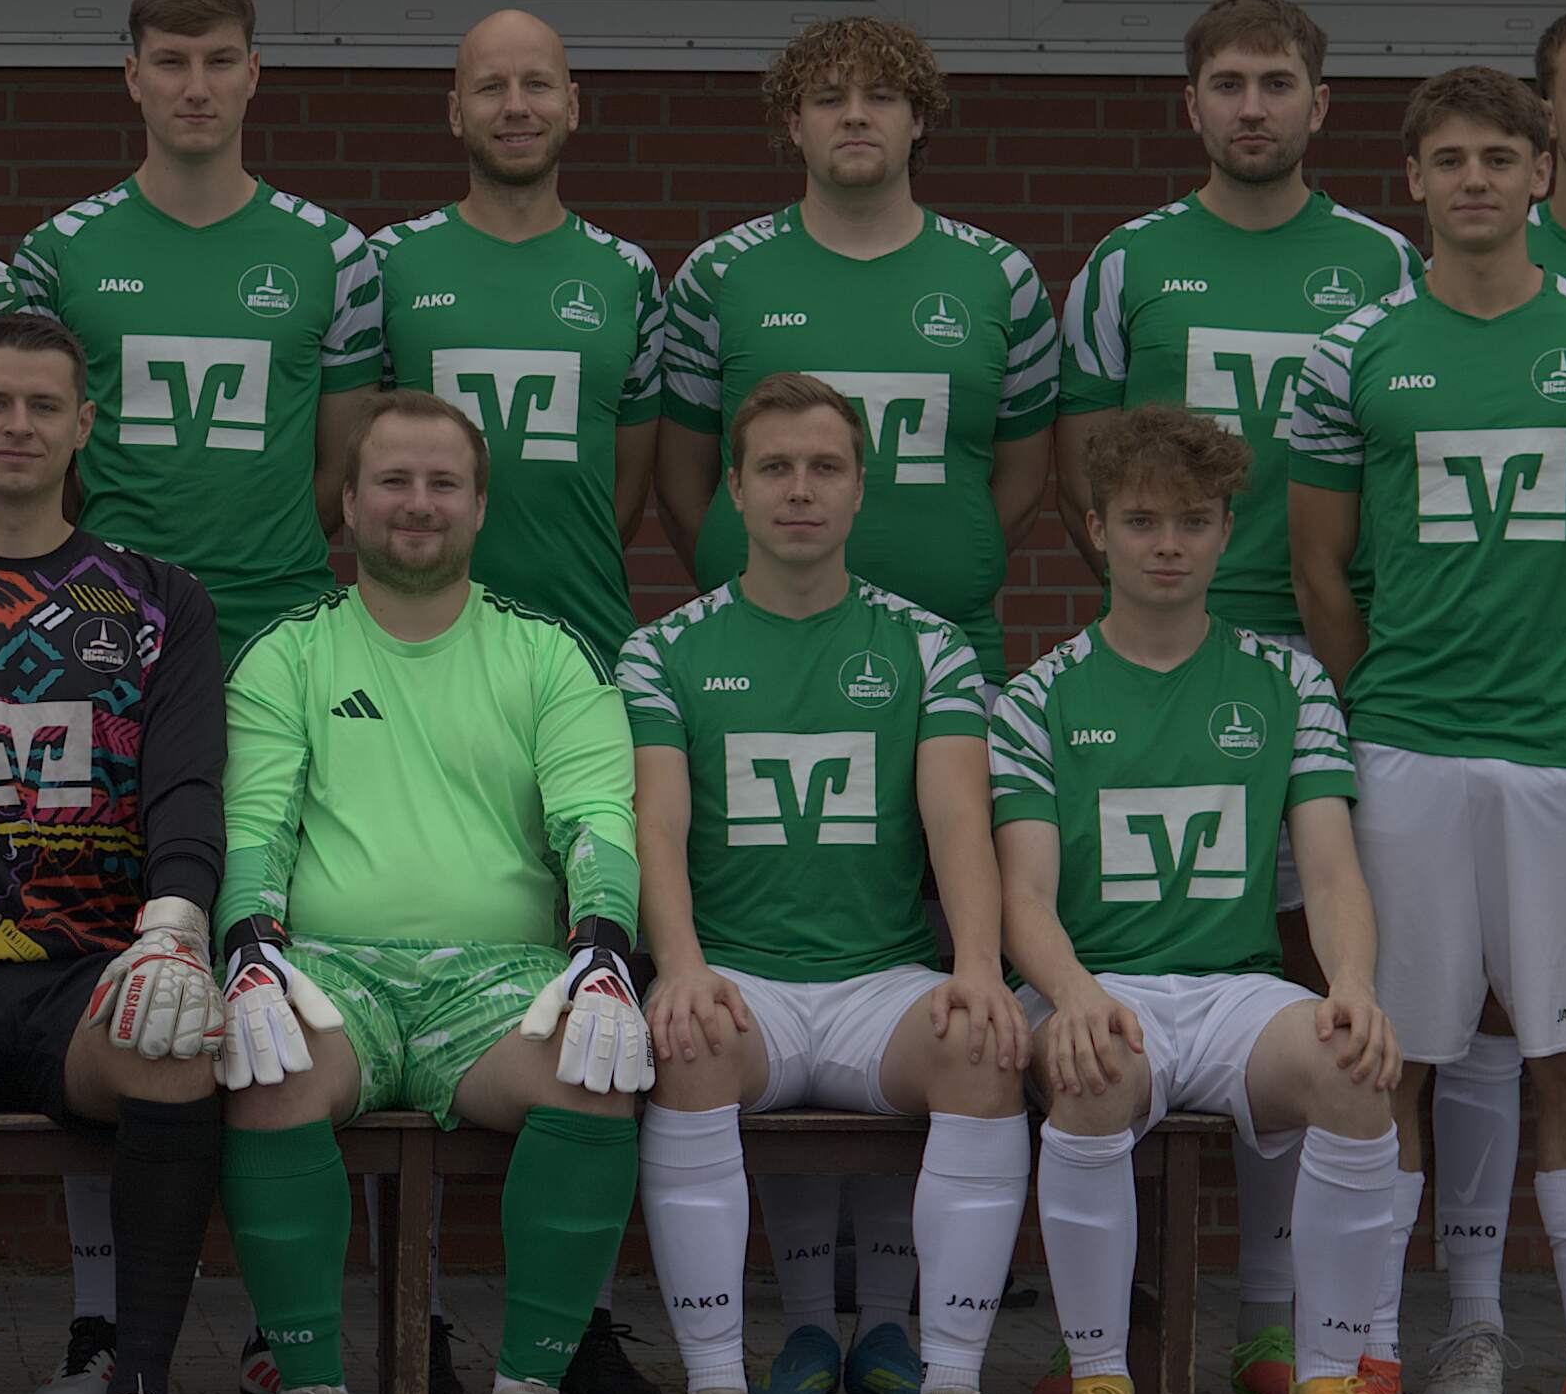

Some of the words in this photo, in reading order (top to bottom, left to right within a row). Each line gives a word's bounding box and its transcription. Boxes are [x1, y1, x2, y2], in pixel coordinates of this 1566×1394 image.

[98, 278, 143, 293] JAKO
[1162, 279, 1207, 293] JAKO
[412, 293, 455, 309] JAKO
[761, 312, 807, 327] JAKO
[1389, 374, 1436, 390] JAKO
[703, 676, 750, 692] JAKO
[1070, 729, 1116, 746] JAKO
[117, 974, 147, 1040] DERBYSTAR
[1444, 1223, 1497, 1238] JAKO
[74, 1243, 112, 1258] AKO
[785, 1242, 831, 1261] JAKO
[672, 1293, 729, 1309] JAKO
[946, 1294, 1000, 1311] JAKO
[1321, 1318, 1370, 1334] JAKO
[1064, 1329, 1103, 1341] AKO
